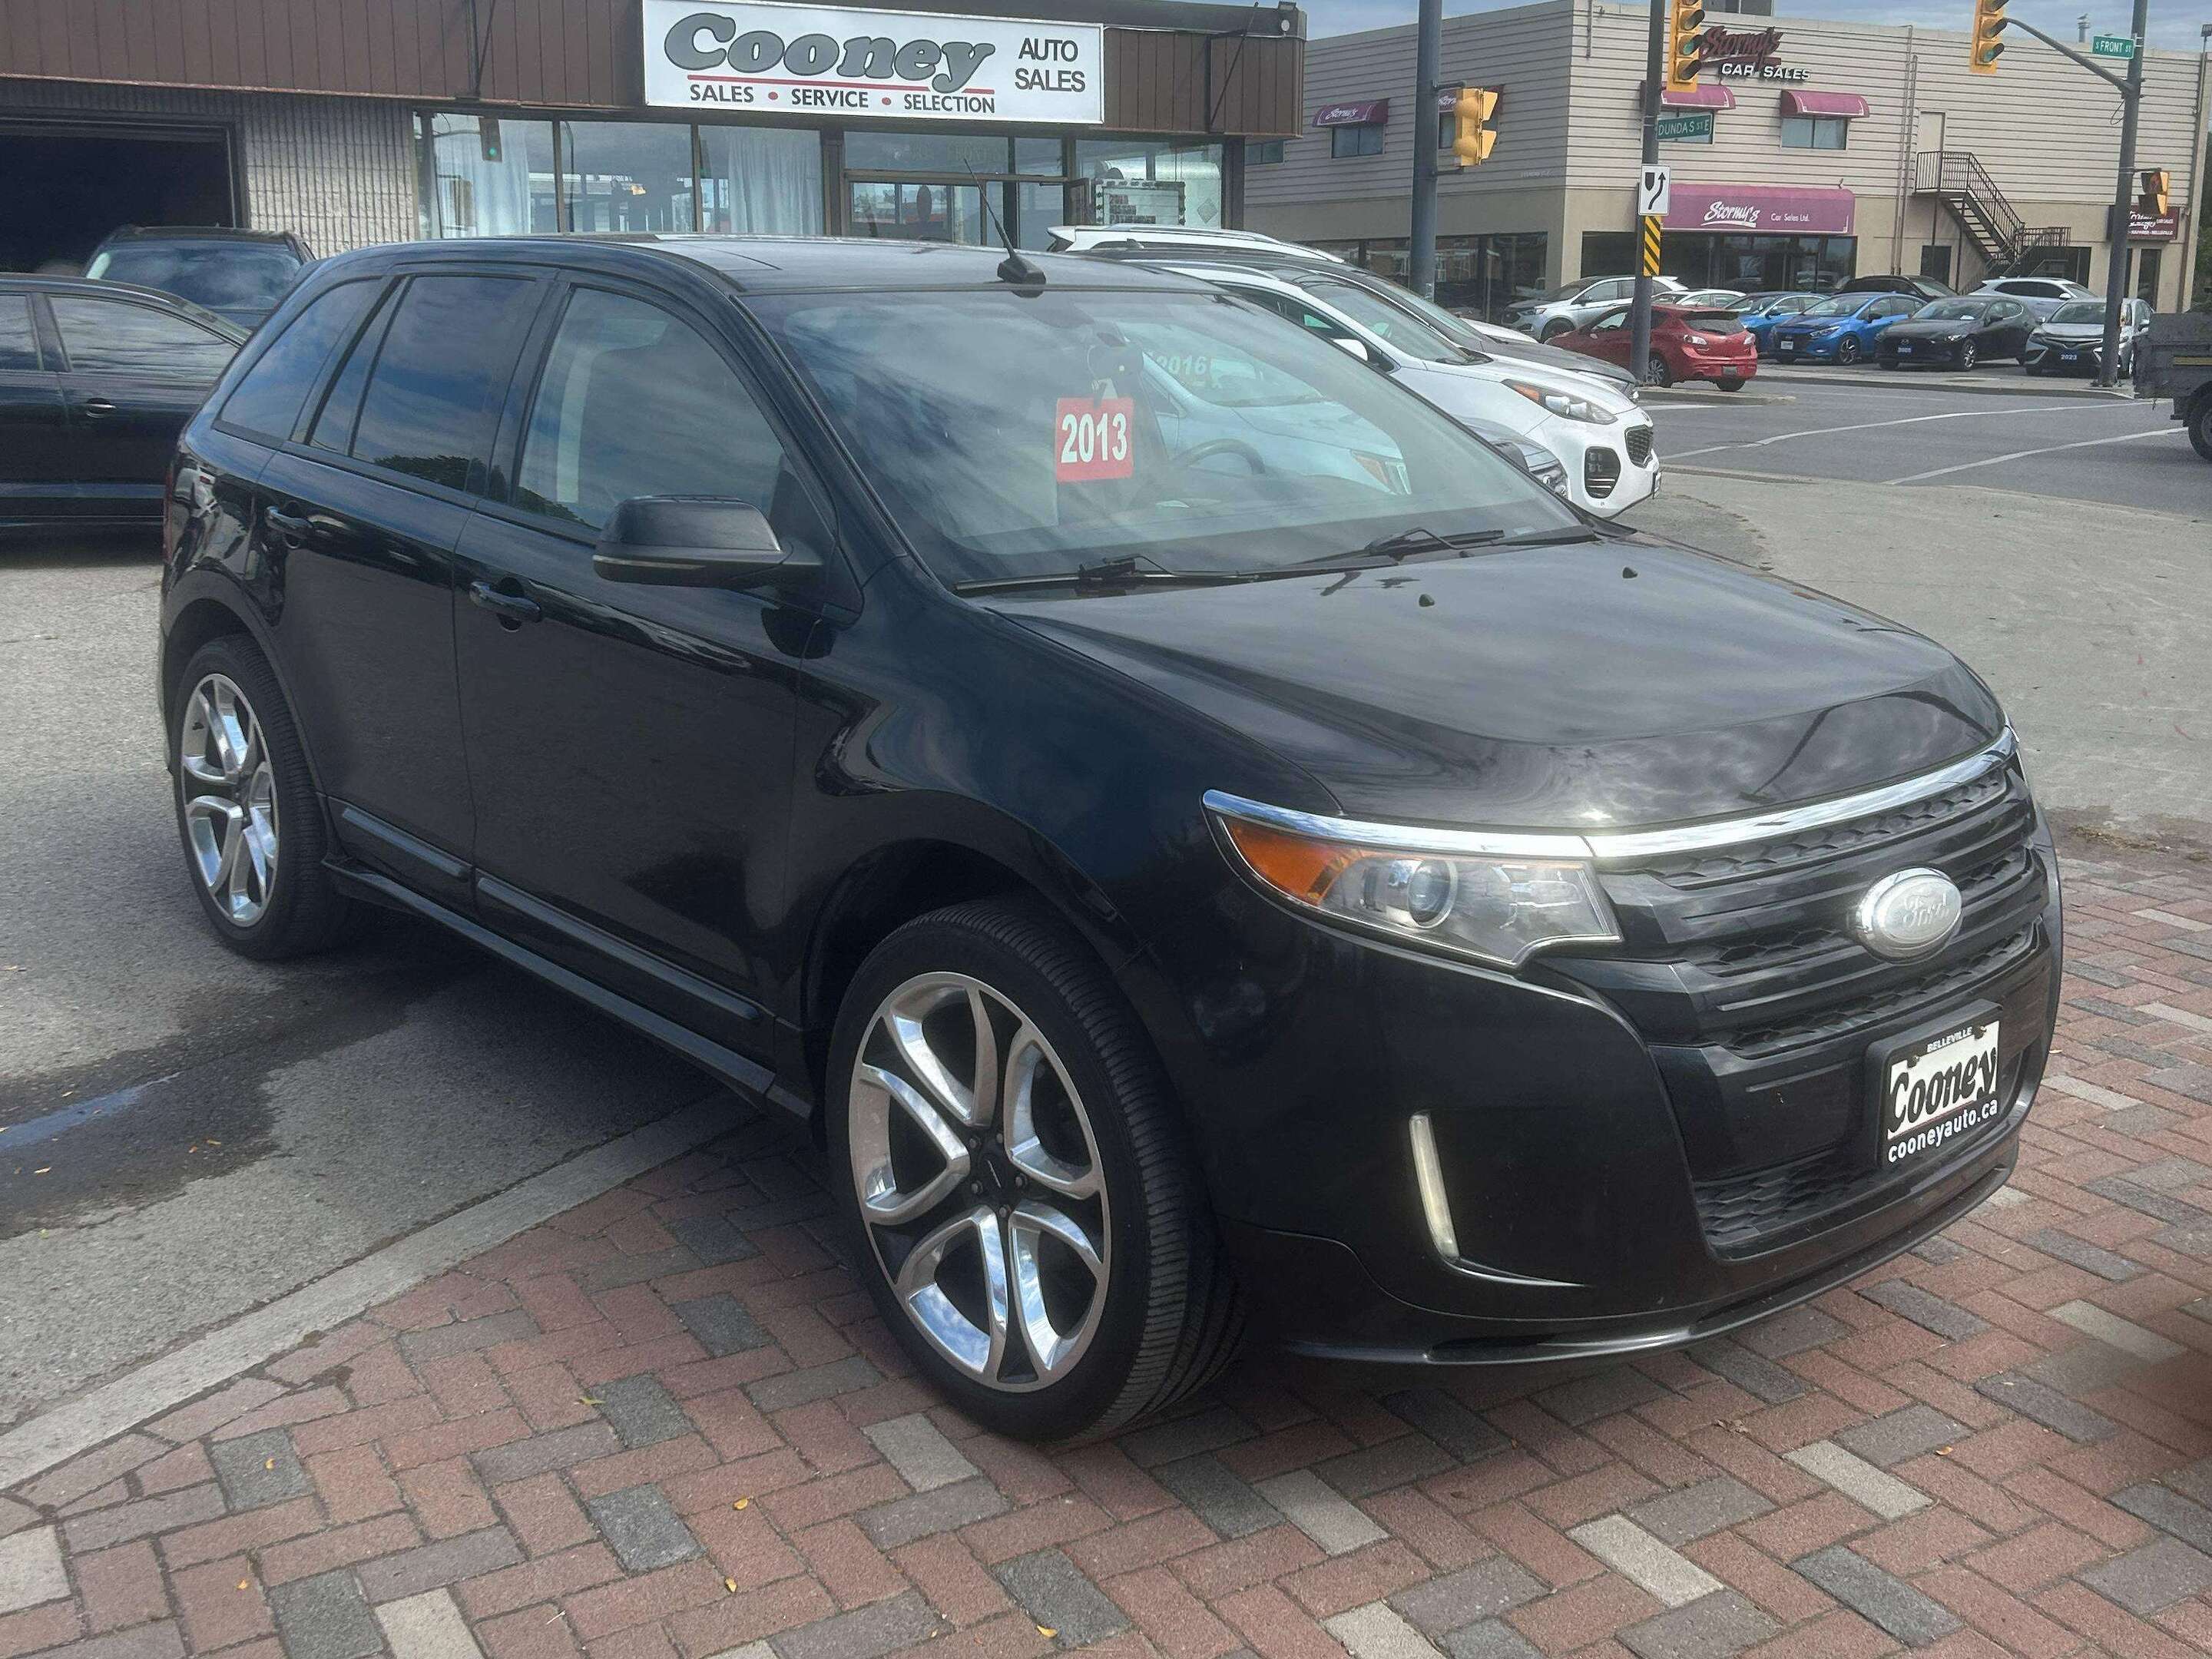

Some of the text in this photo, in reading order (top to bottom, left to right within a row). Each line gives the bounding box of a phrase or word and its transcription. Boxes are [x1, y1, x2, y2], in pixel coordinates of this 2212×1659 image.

[664, 12, 995, 93] Cooney
[1018, 38, 1078, 62] AUTO
[2100, 41, 2124, 52] FRONT
[1015, 68, 1086, 93] SALES
[1721, 63, 1810, 80] CAR SALES
[690, 84, 995, 114] SALES SERVICE SELECTION
[1658, 121, 1695, 136] DUNDAS
[1704, 119, 1710, 131] E
[1704, 200, 1761, 223] Stormy's
[1770, 213, 1782, 221] Car
[1783, 214, 1799, 222] Sales
[1061, 412, 1128, 463] 2013
[1926, 1026, 1973, 1053] BELLEVILLE
[1888, 1047, 1997, 1133] Cooney
[1888, 1098, 1998, 1163] cooneyauto.ca
